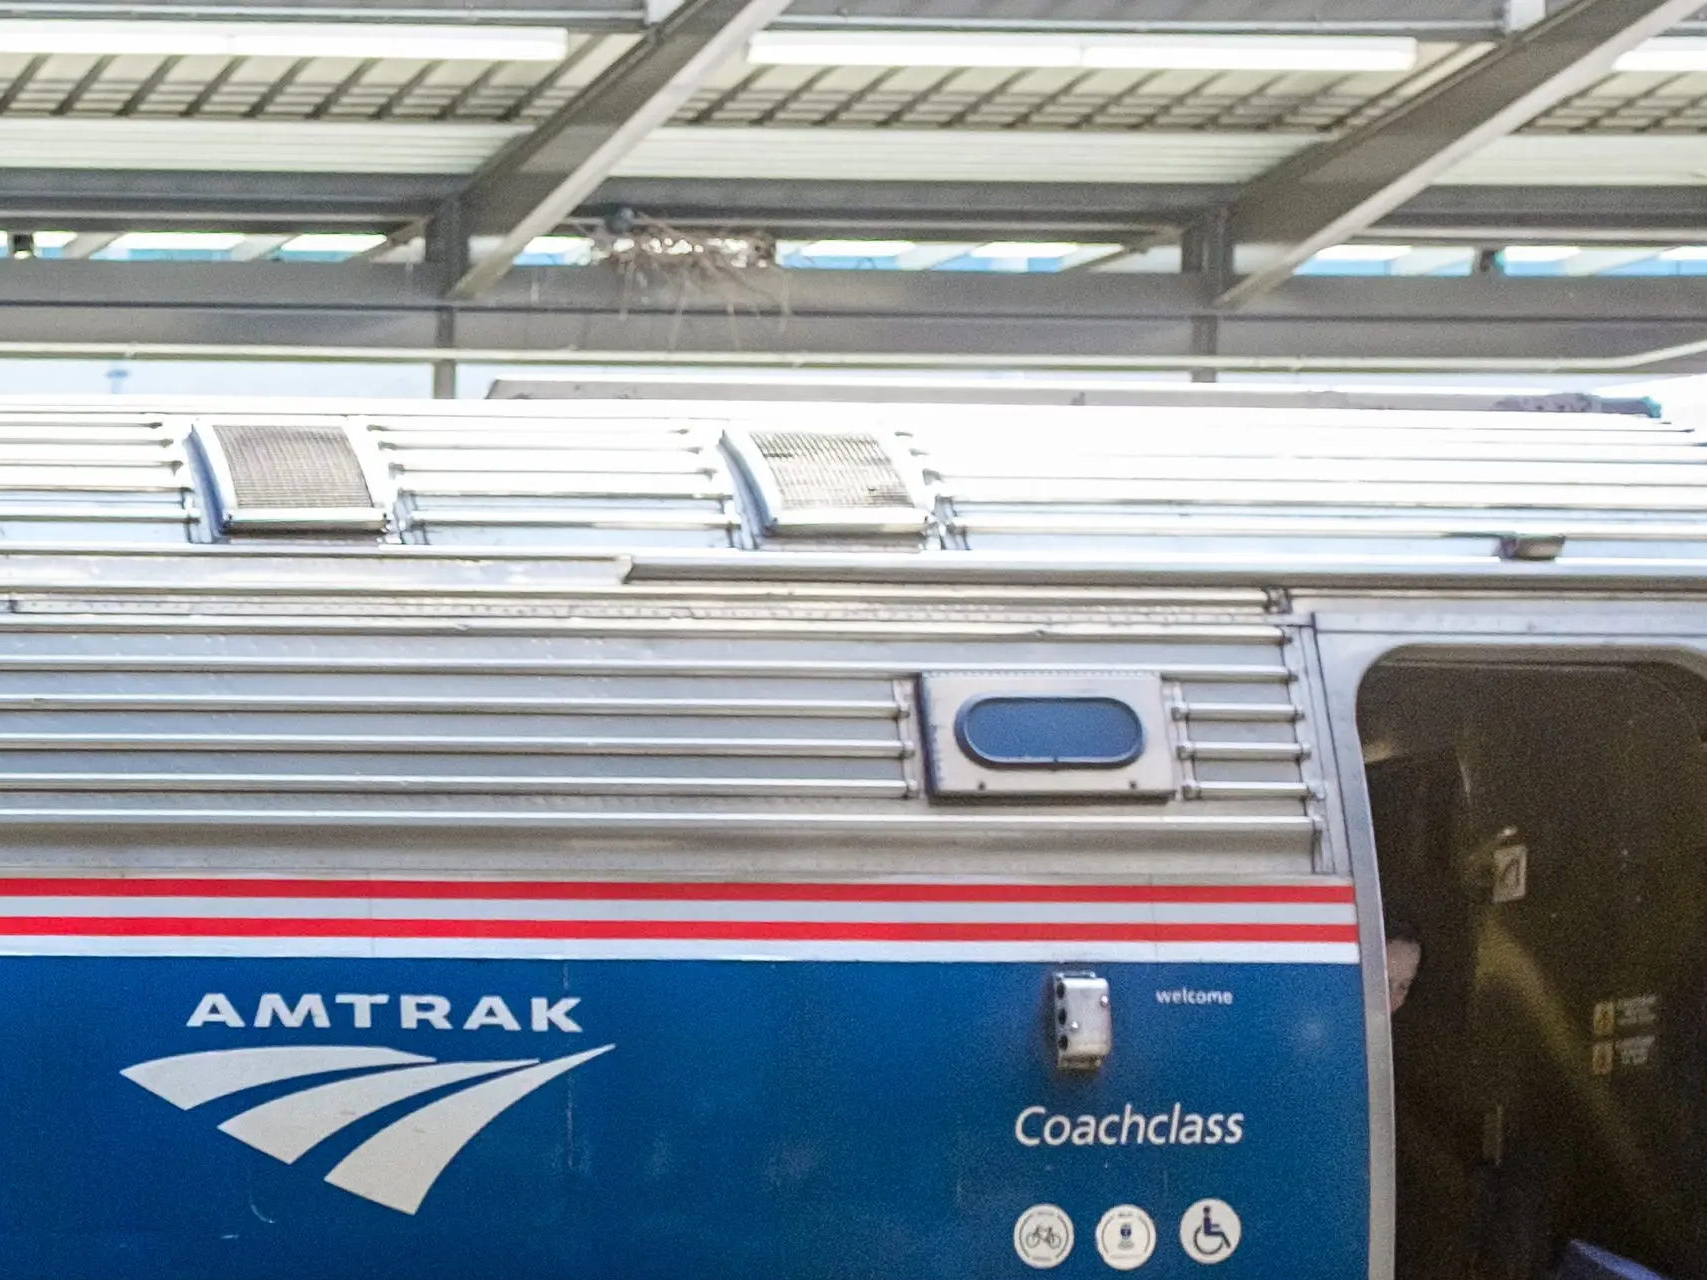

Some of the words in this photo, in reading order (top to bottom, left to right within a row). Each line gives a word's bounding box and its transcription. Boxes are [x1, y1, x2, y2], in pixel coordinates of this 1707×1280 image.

[186, 993, 582, 1033] AMTRAK
[1155, 988, 1233, 1004] welcome
[1015, 1102, 1244, 1146] Coachclass
